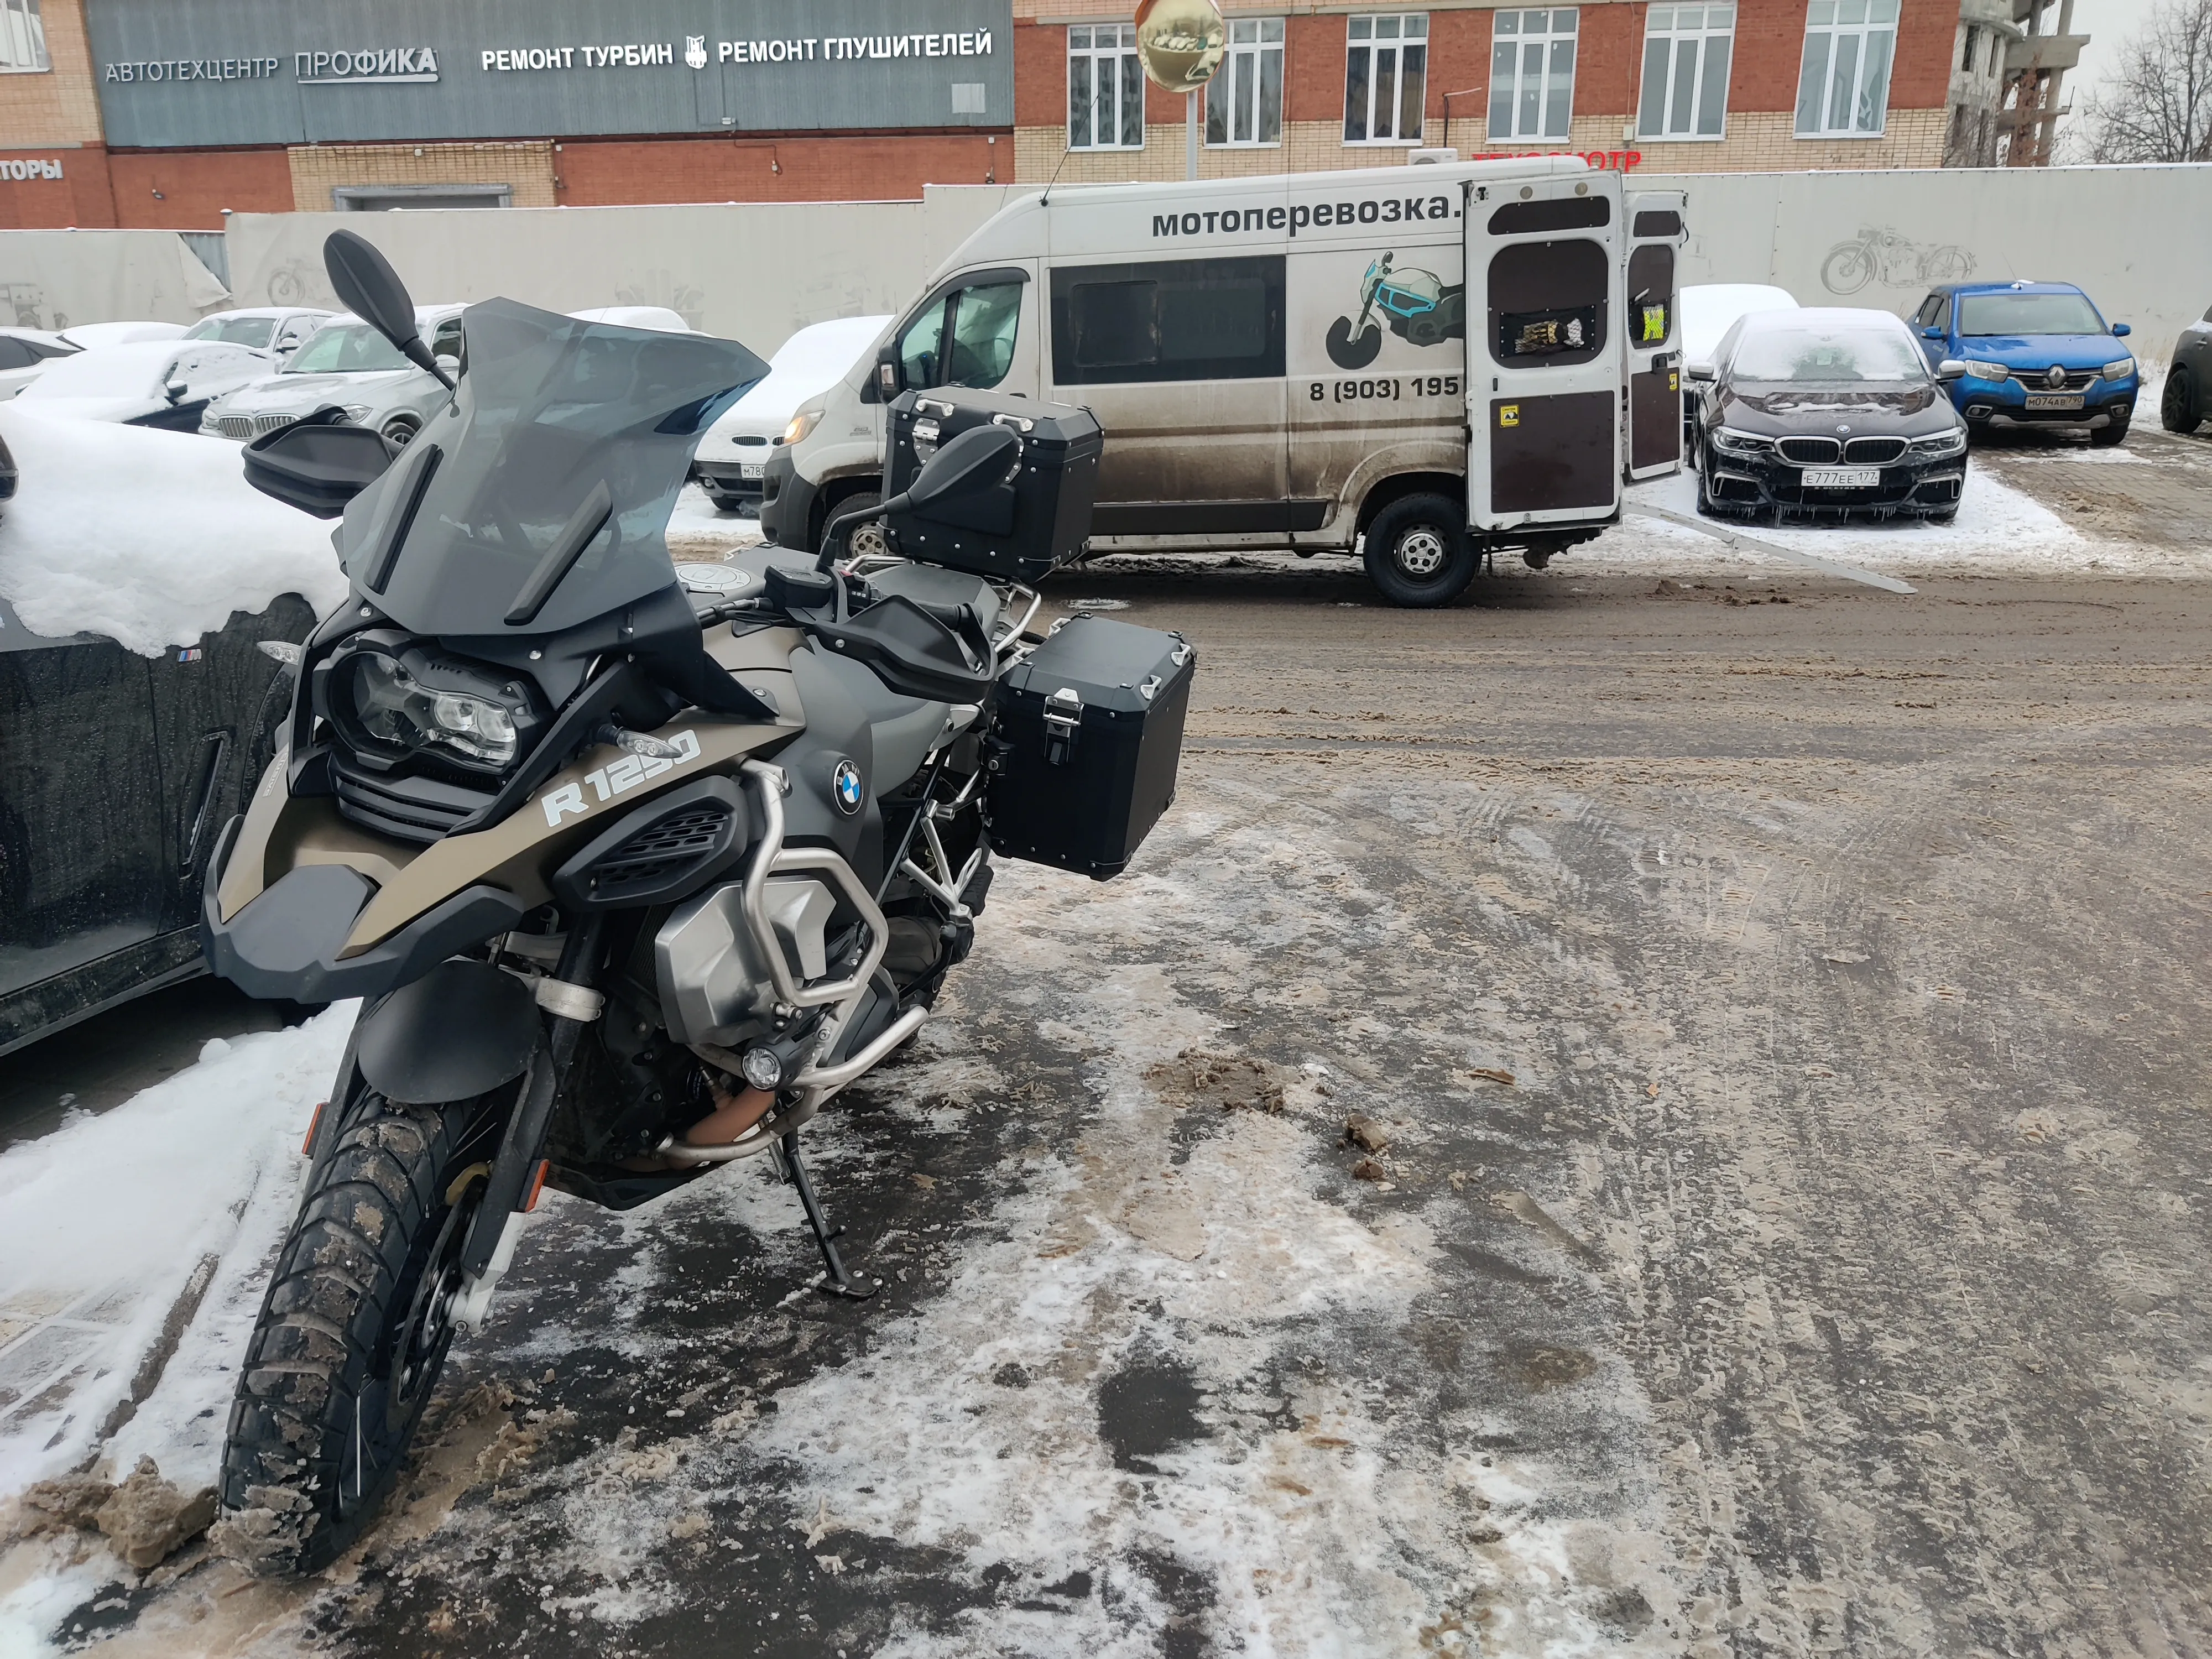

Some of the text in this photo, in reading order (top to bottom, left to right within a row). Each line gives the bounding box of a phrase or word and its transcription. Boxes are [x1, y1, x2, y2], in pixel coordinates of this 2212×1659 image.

[482, 44, 673, 70] РЕМОНТ ТУРБИН
[718, 27, 992, 63] РЕМОНТ ГЛУШИТЕЛЕЙ
[106, 48, 438, 82] АВТОТЕХЦЕНТР ПРОФИКА
[0, 159, 64, 180] ТОРЫ
[1153, 196, 1461, 237] мотоперевозка.
[1310, 377, 1458, 403] 8 (903) 195
[1806, 472, 1876, 483] Е777ЕЕ 177
[541, 782, 589, 827] R
